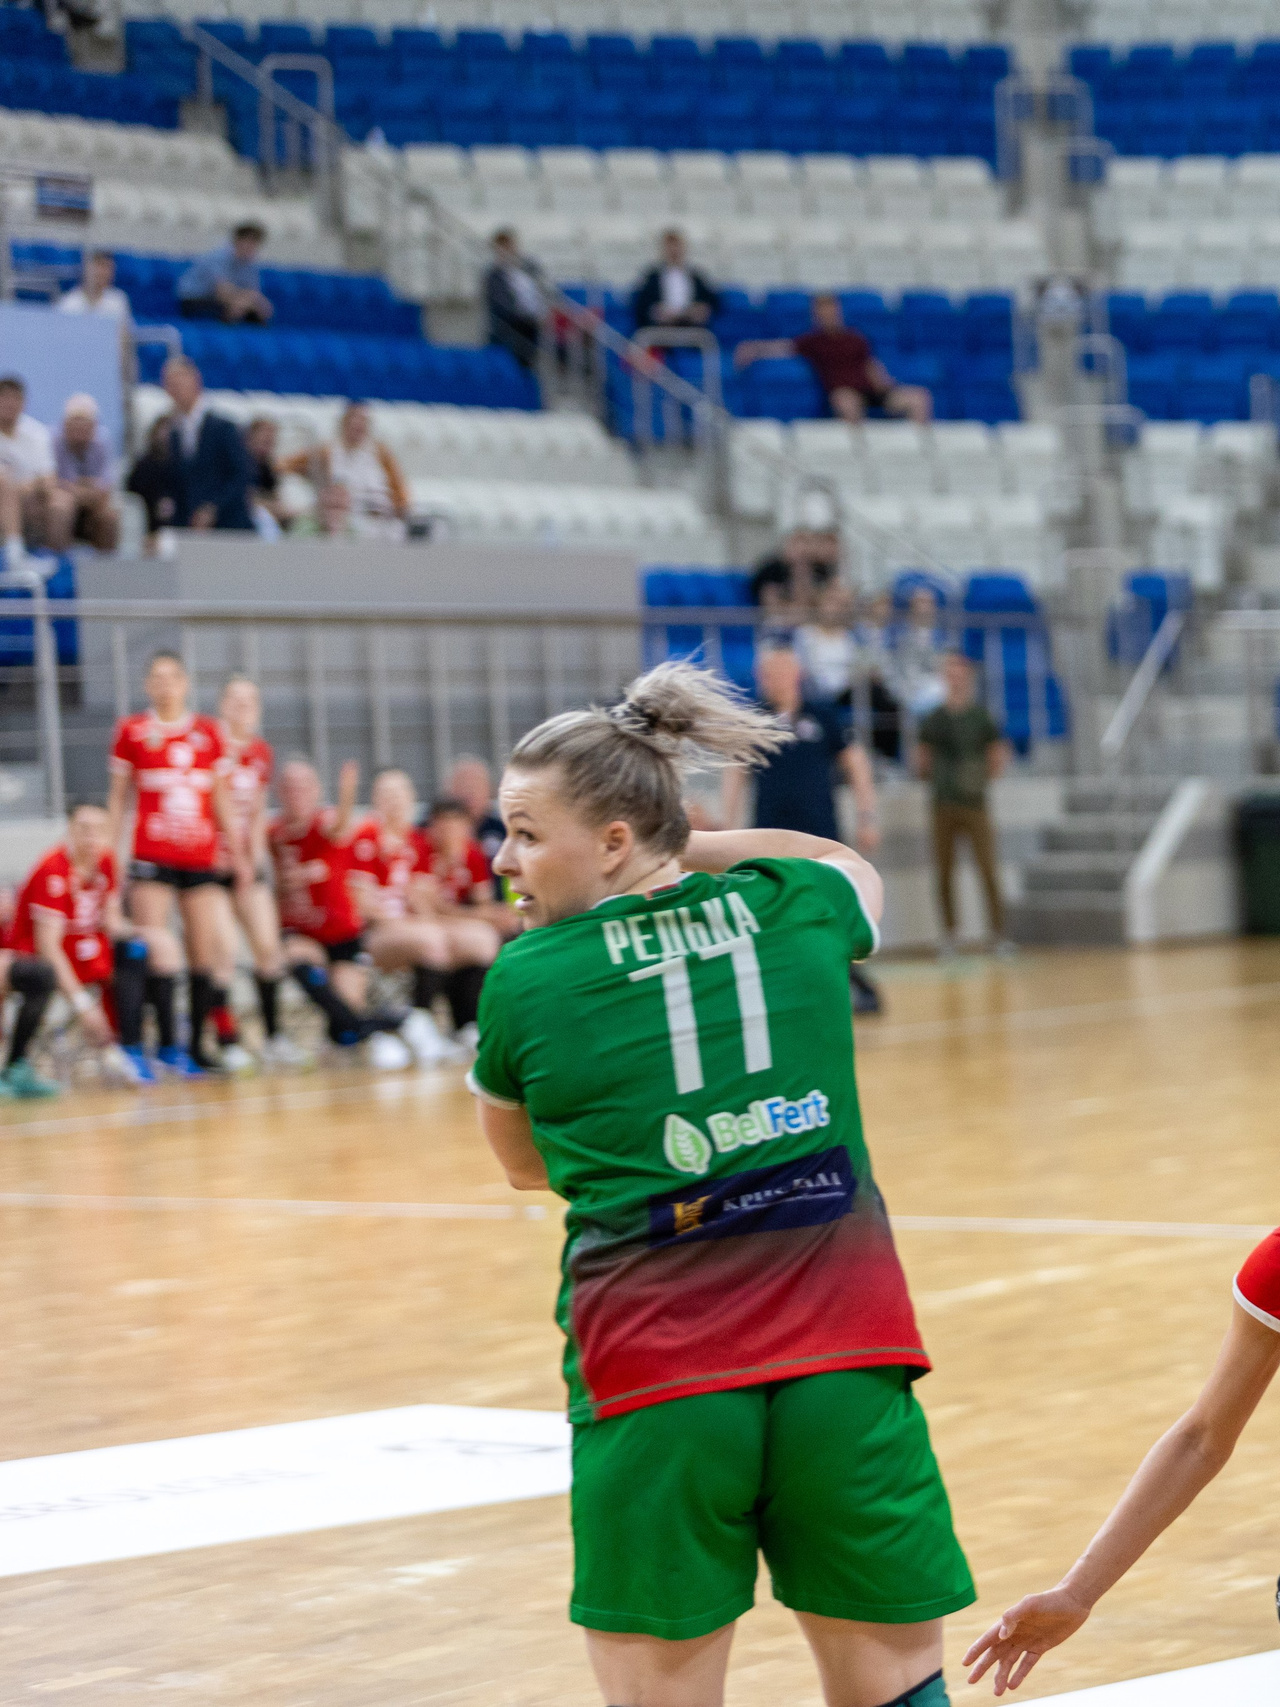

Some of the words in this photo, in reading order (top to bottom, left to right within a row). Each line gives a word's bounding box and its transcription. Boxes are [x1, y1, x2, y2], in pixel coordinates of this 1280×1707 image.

[601, 891, 761, 965] РЕДЬКА
[628, 934, 773, 1095] 77
[707, 1091, 829, 1152] BelFert
